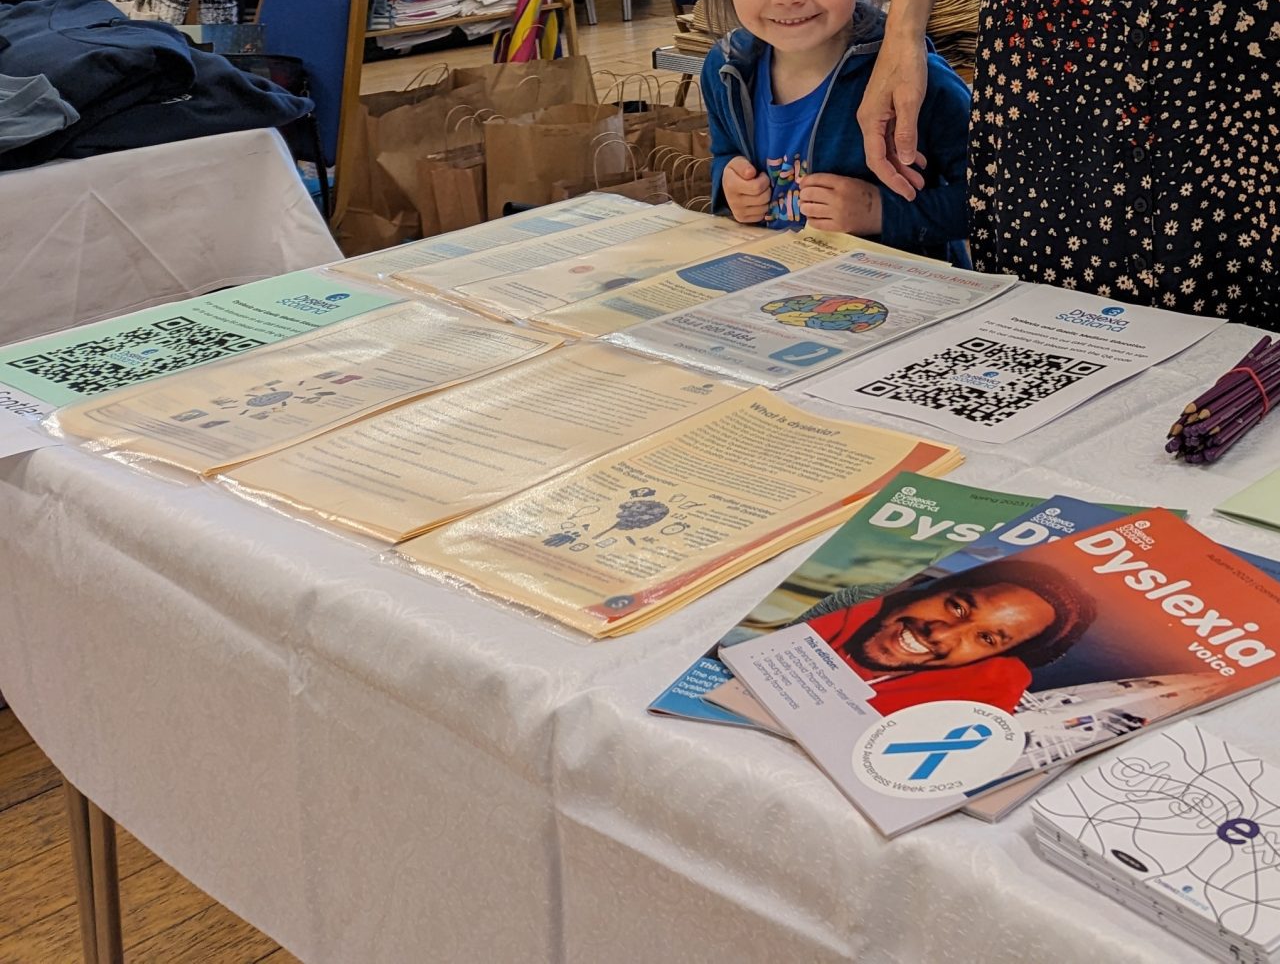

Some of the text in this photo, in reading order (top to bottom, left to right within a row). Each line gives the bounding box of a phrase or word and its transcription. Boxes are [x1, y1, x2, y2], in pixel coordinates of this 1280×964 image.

[1069, 309, 1130, 327] Dyslexia
[749, 402, 841, 437] What is dyslexia?
[893, 492, 938, 505] Dyslexia
[969, 494, 1025, 507] Spring 2023
[1074, 530, 1276, 668] Dyslexia
[803, 636, 839, 670] This edition:
[1187, 641, 1236, 677] voice
[692, 669, 708, 679] The
[699, 661, 721, 672] This
[862, 720, 964, 793] Dyslexia Awareness Week 2023
